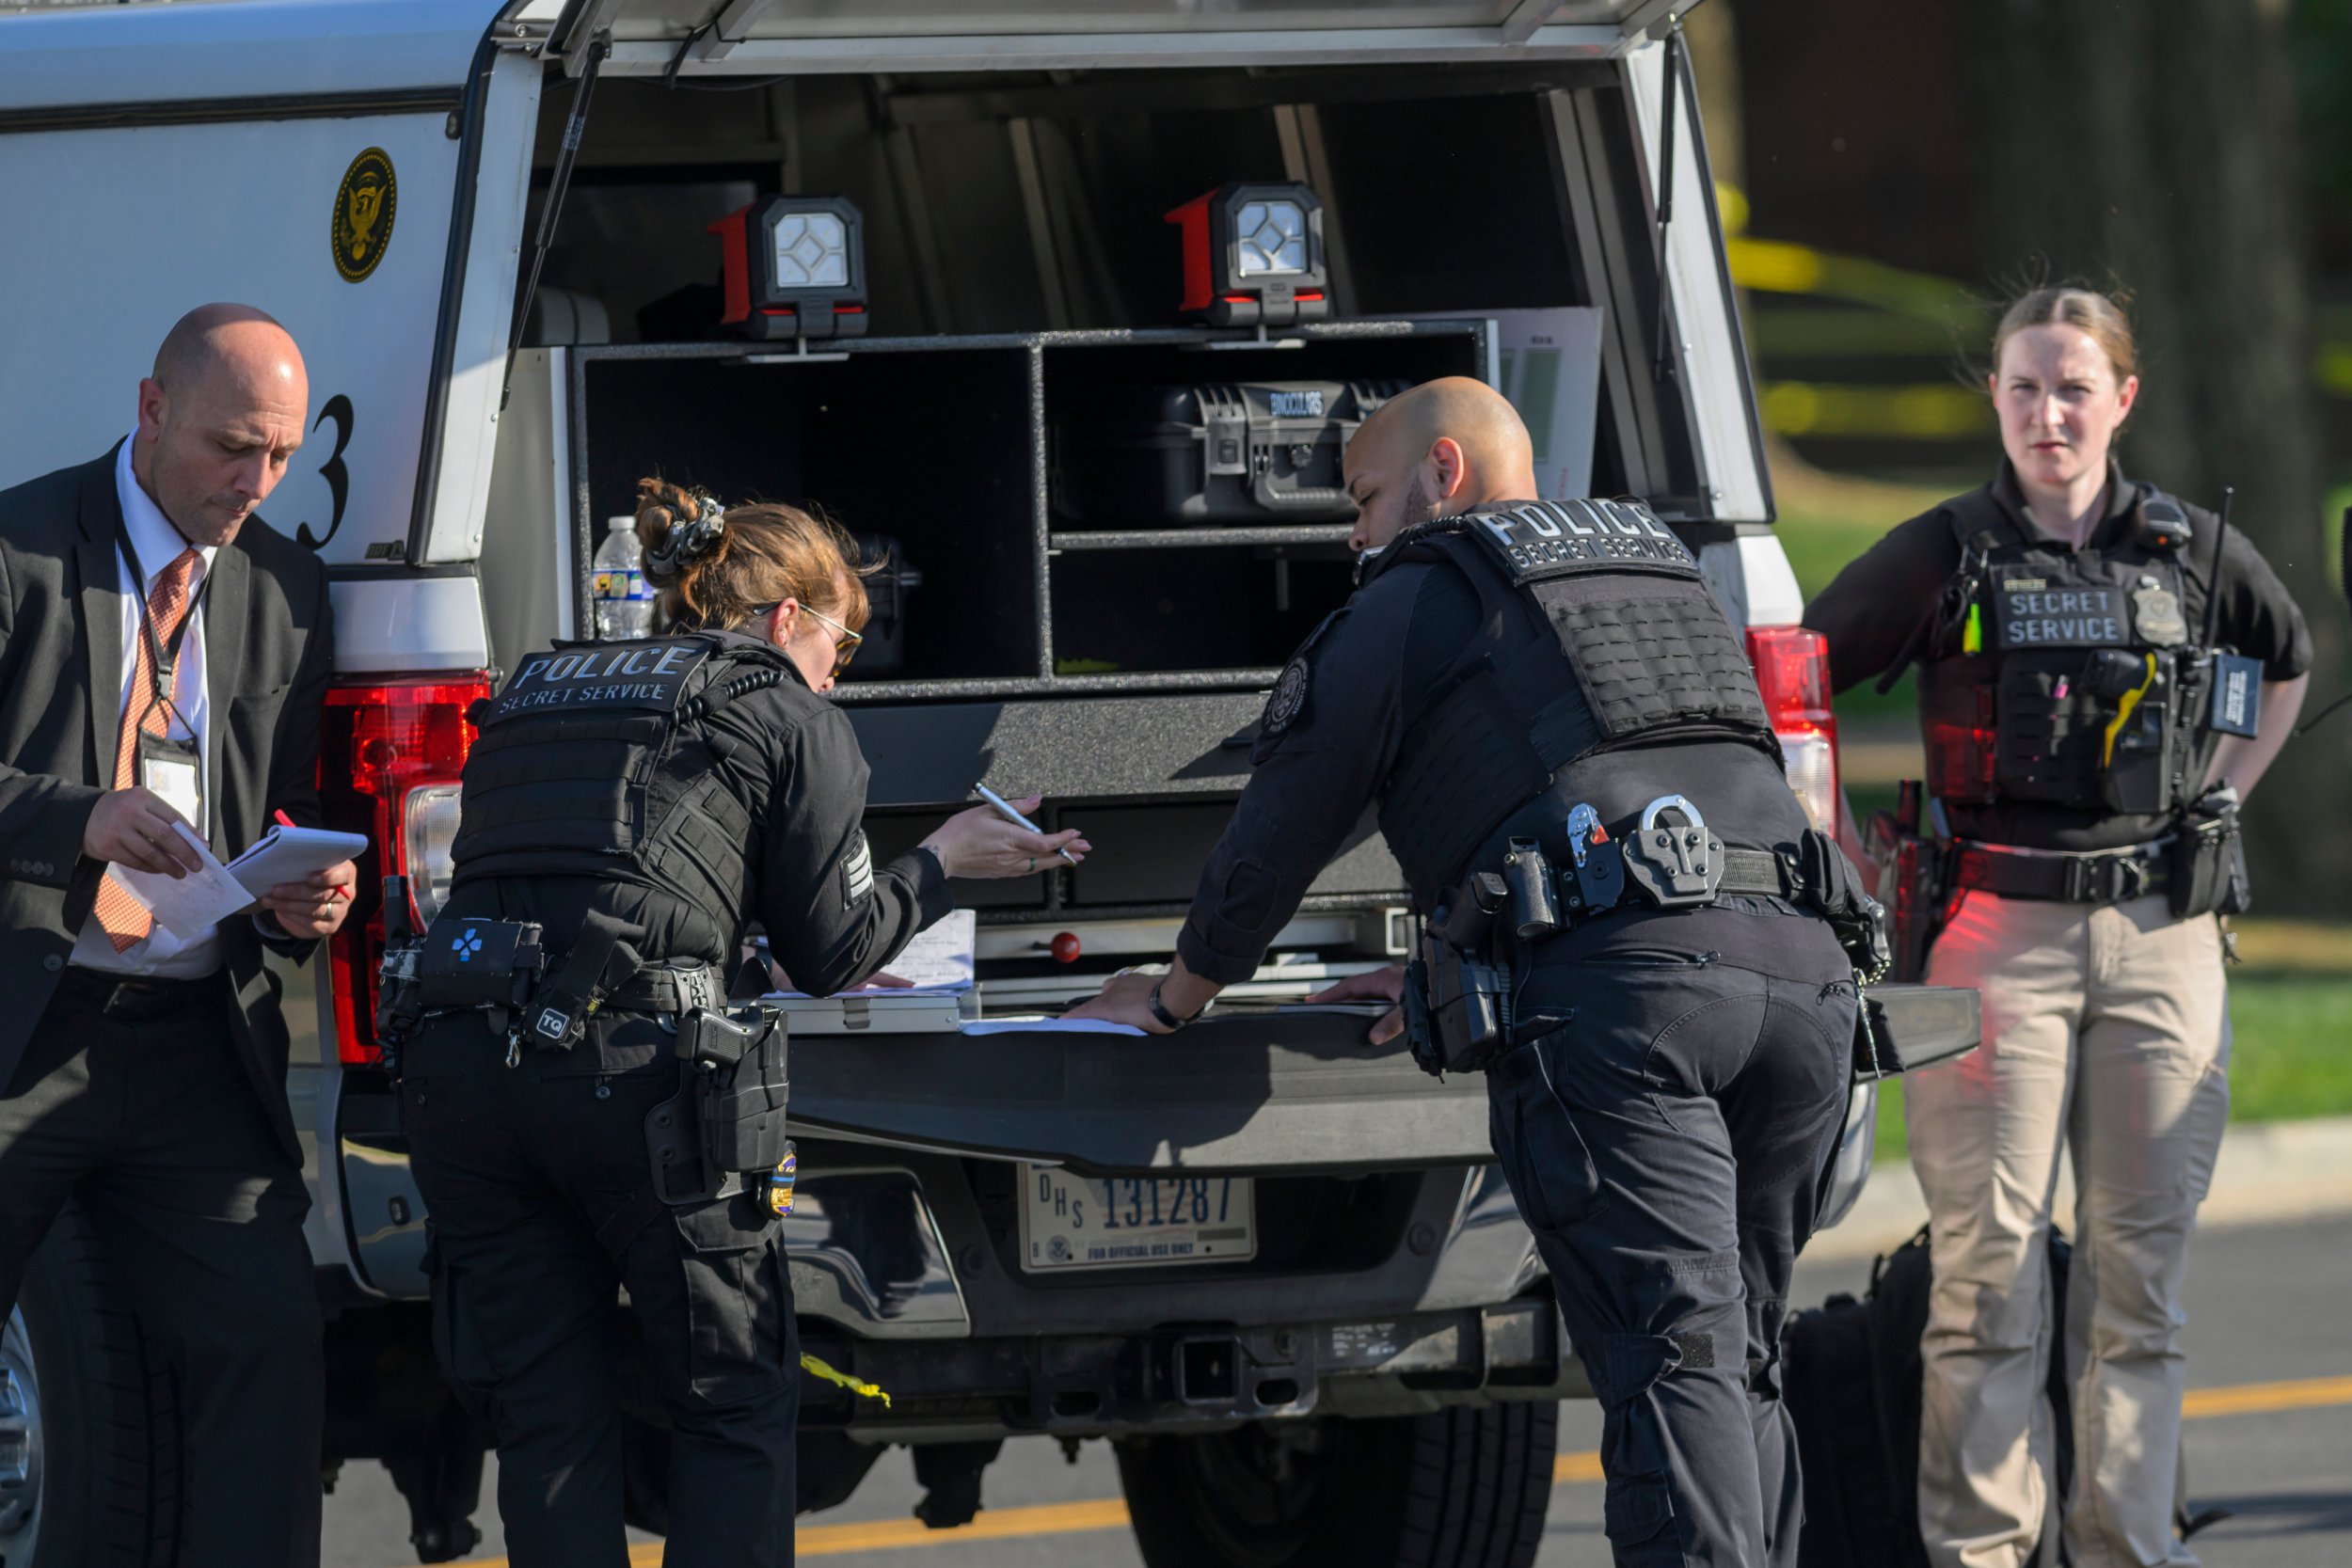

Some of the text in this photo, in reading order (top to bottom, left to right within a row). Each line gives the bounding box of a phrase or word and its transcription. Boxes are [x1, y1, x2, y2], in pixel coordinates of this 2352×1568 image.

[296, 394, 354, 550] 3
[1476, 499, 1671, 546] POLICE
[1509, 537, 1692, 567] SECRET SERVICE
[2010, 592, 2108, 614] SECRET
[2009, 618, 2119, 642] SERVICE
[515, 646, 697, 689] POLICE
[500, 683, 669, 713] SECRET SERVICE
[543, 1014, 563, 1033] TQ
[1088, 1242, 1195, 1260] FOR OFFICIAL USE ONLY
